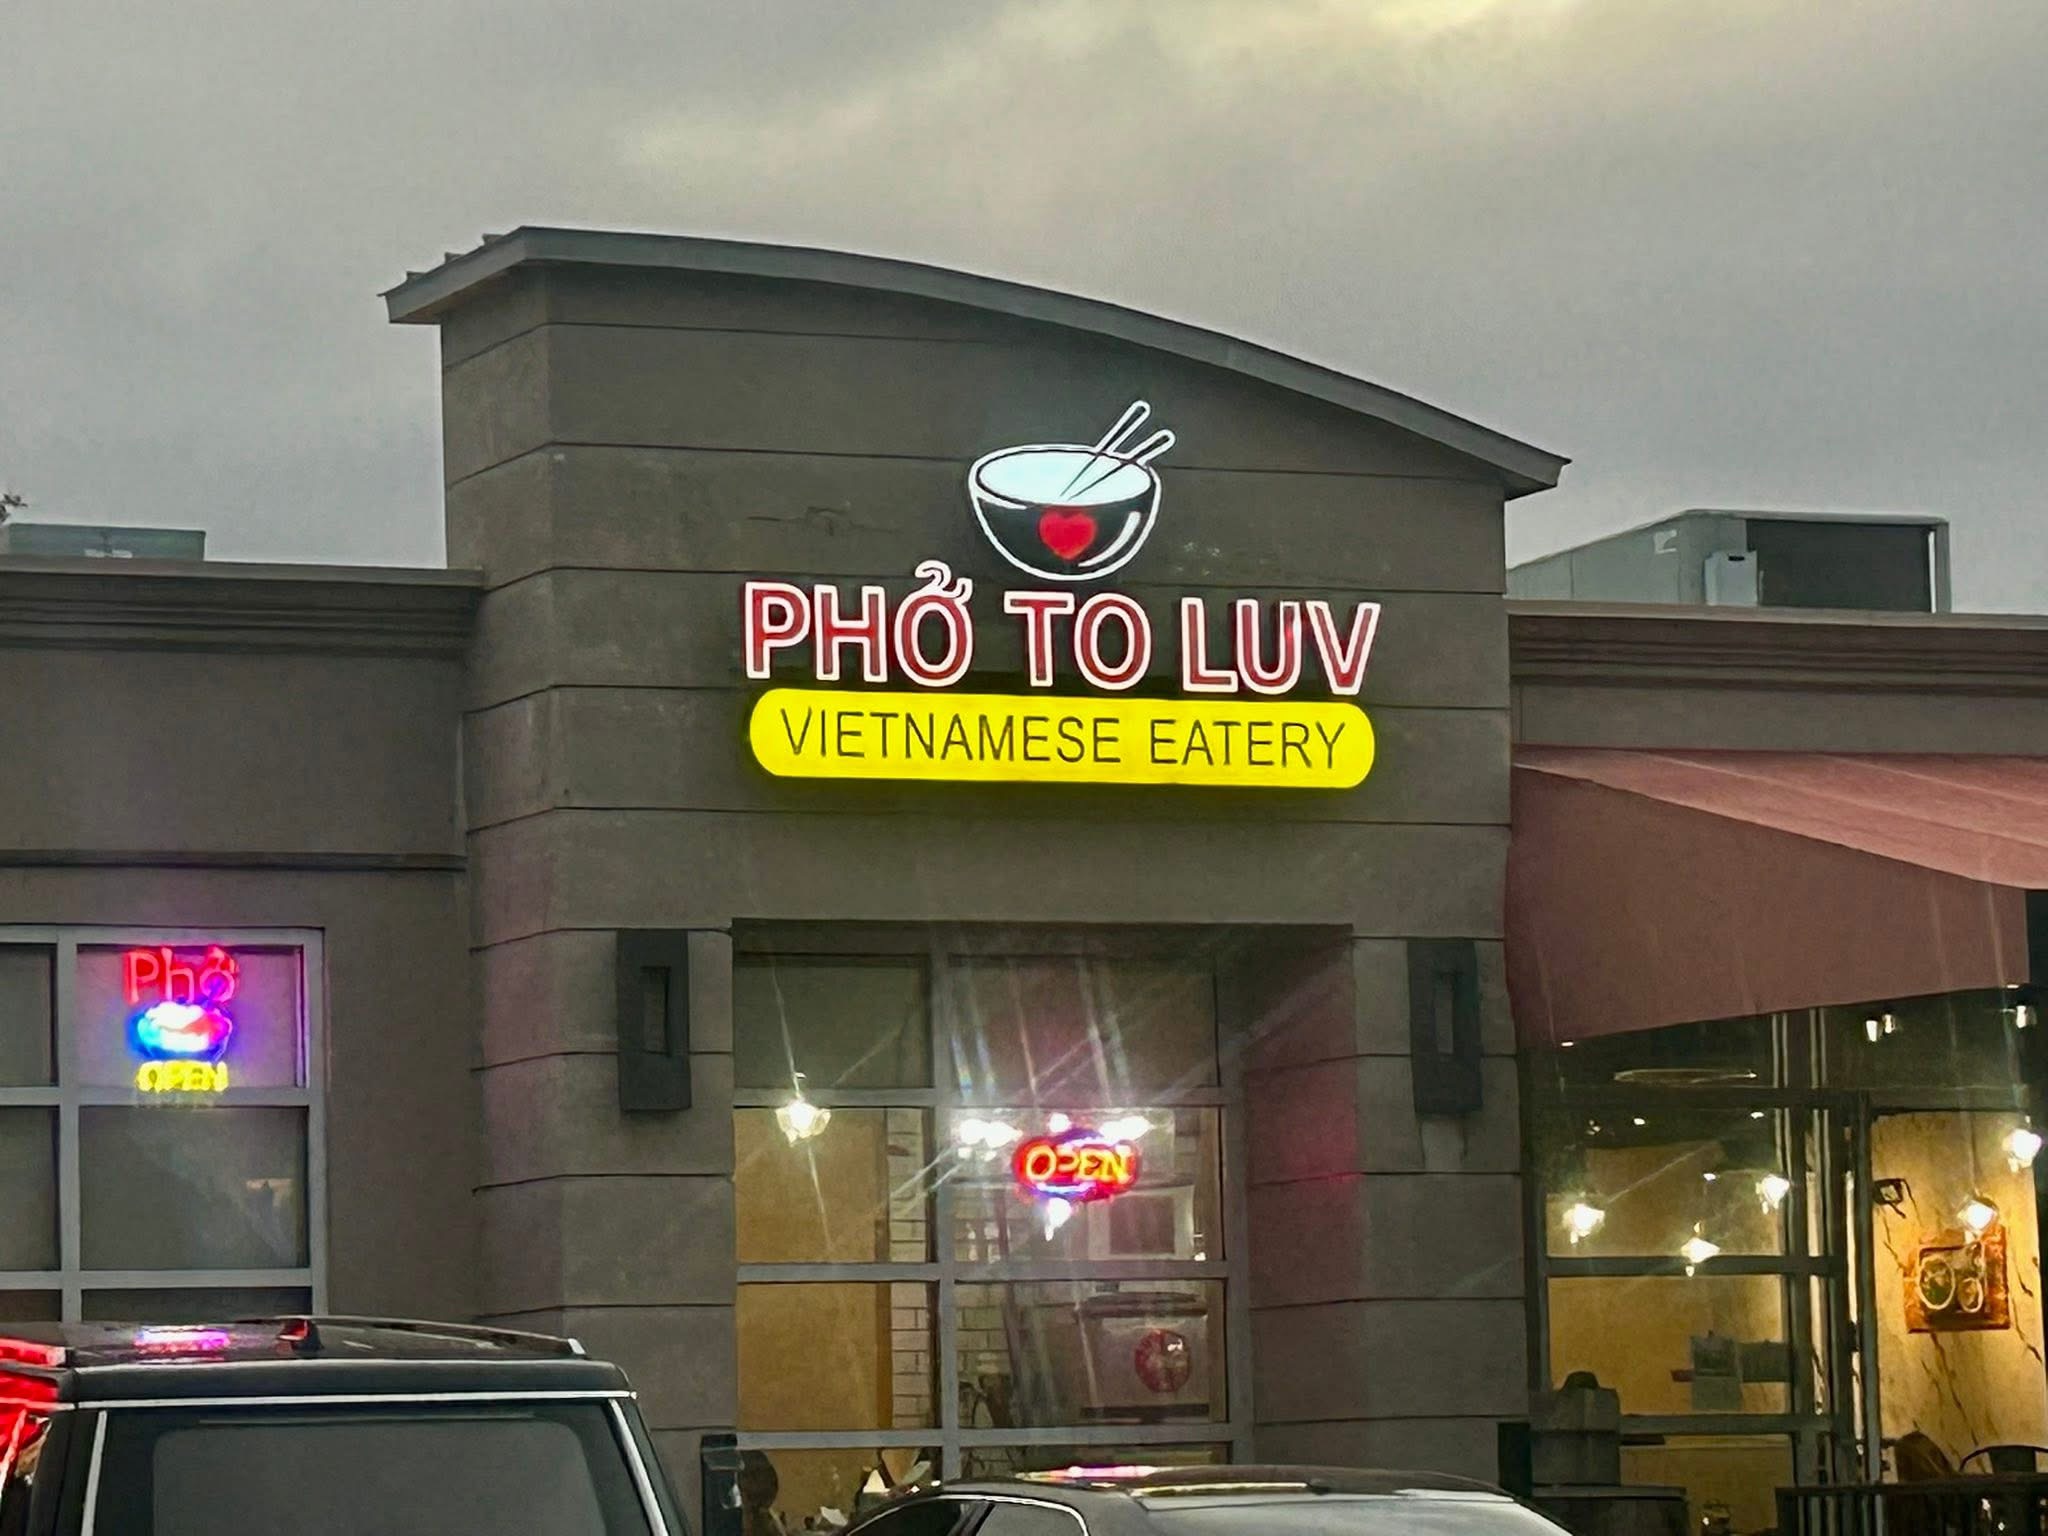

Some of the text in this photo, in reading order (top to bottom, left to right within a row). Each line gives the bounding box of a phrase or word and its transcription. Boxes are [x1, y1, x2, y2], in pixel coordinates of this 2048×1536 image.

[743, 560, 1381, 695] PHỞ TO LUV
[781, 707, 1346, 769] VIETNAMESE EATERY
[136, 1060, 229, 1092] OPEN
[1026, 1143, 1132, 1184] OPEN
